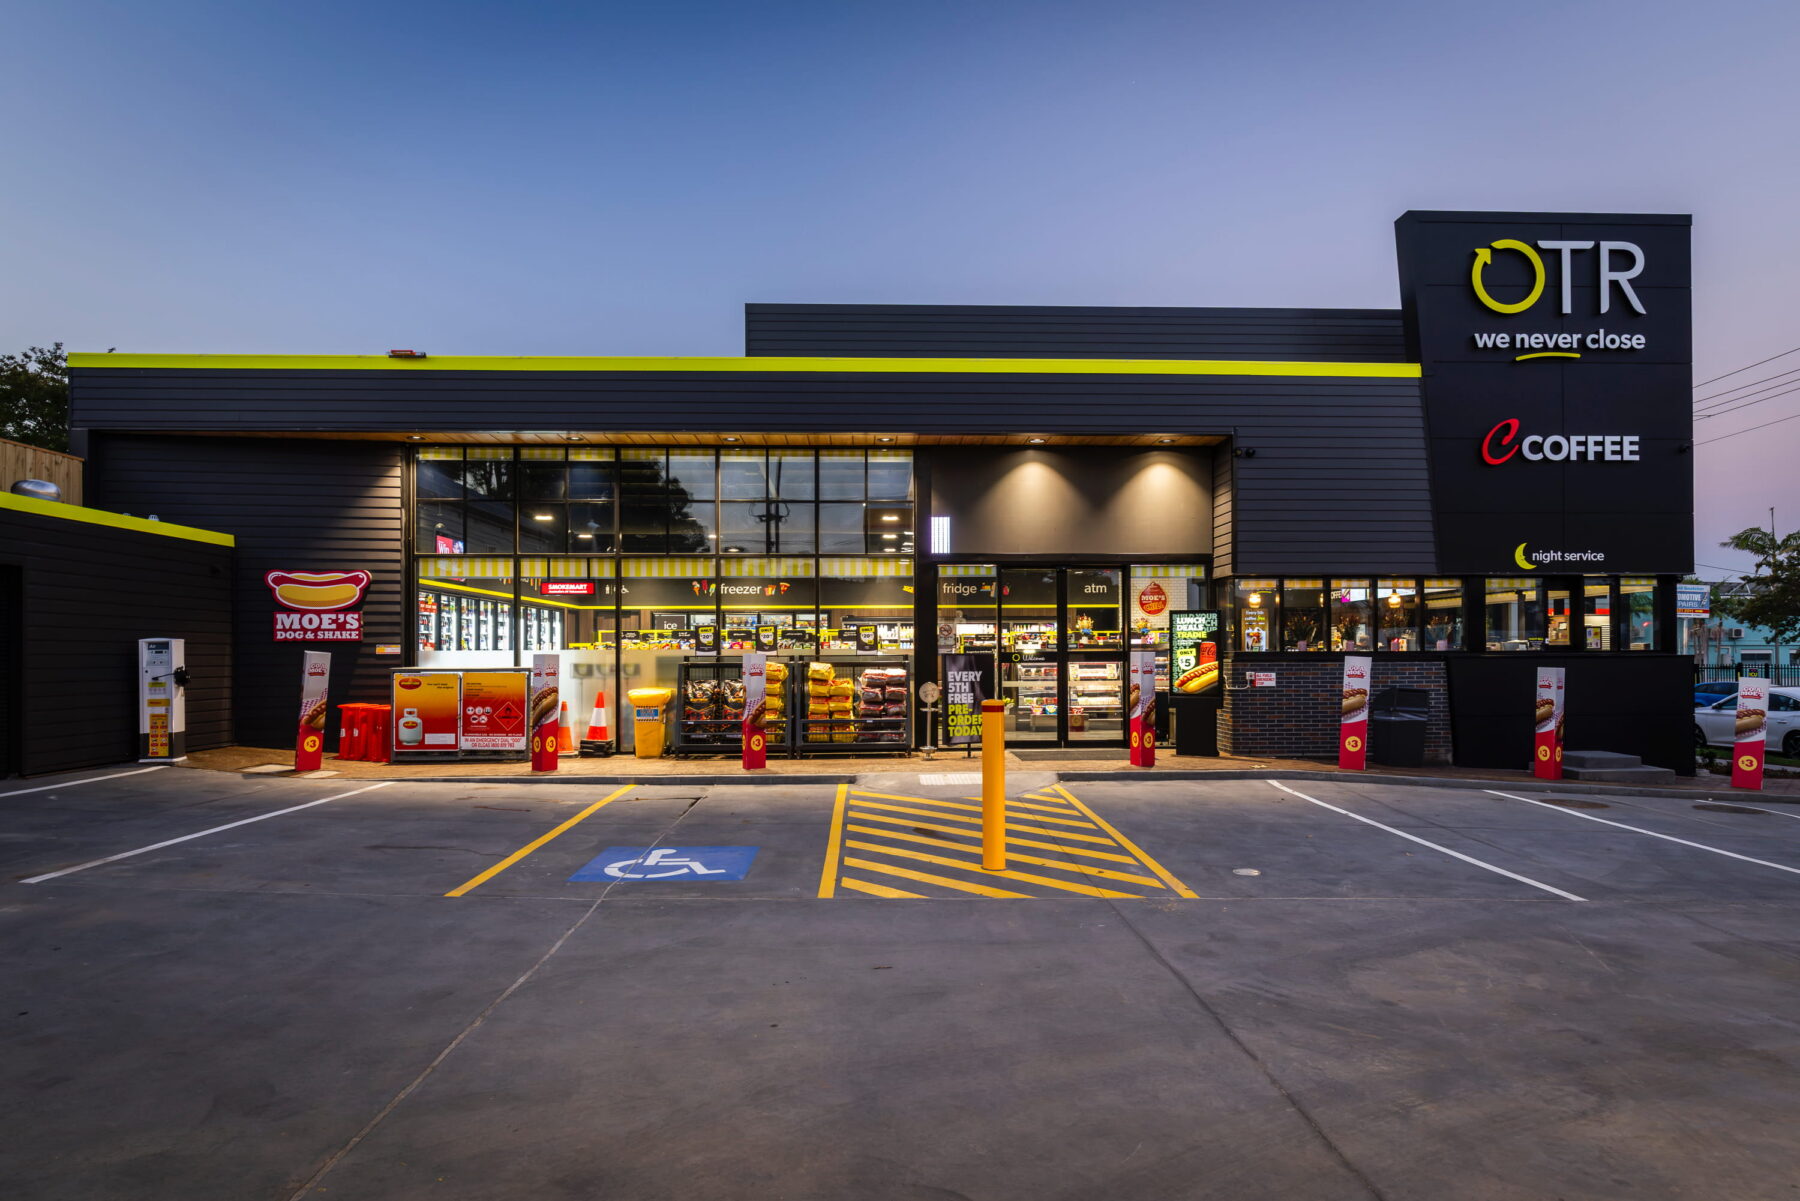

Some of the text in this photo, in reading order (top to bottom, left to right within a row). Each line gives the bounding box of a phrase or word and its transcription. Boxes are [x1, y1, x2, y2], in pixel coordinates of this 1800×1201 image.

[1471, 239, 1646, 314] OTR
[1474, 328, 1646, 349] we never close
[1522, 435, 1640, 461] COFFEE
[1532, 550, 1604, 563] night service
[720, 583, 762, 594] freezer
[942, 583, 977, 596] fridge
[1084, 584, 1107, 594] atm
[276, 614, 359, 629] MOE'S
[664, 621, 677, 630] ice
[276, 631, 359, 639] DOG & SHAKE
[1180, 659, 1191, 667] $5
[948, 671, 982, 681] EVERY
[948, 682, 969, 692] 5TH
[948, 693, 974, 703] FREE
[948, 704, 972, 714] PRE-
[948, 726, 982, 736] TODAY
